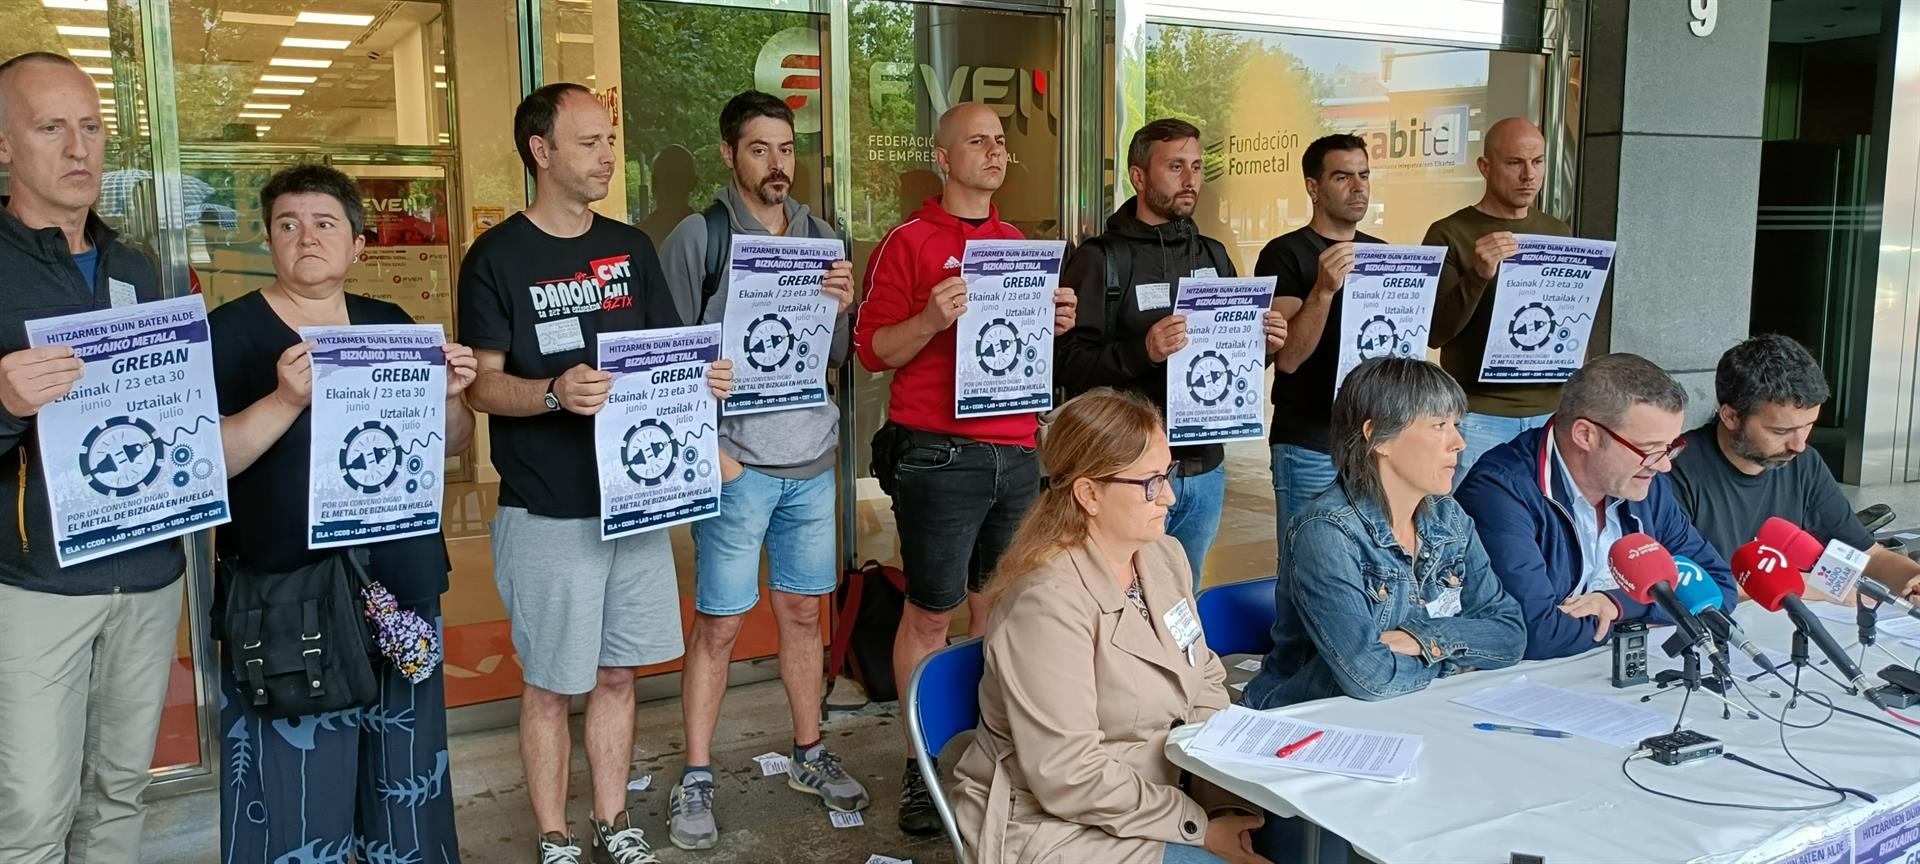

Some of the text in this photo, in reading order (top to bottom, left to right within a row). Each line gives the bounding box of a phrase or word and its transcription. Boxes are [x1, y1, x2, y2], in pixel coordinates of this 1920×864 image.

[1690, 0, 1717, 37] 9
[1229, 130, 1299, 154] Fundación
[869, 150, 937, 163] DE EMPRES
[1228, 152, 1290, 176] Formetal
[741, 246, 838, 257] HITZARMEN DUIN BATEN ALDE
[1564, 246, 1586, 254] BATEN
[755, 259, 823, 269] BIZKAIKO METALA
[598, 261, 631, 281] CNT
[1541, 267, 1592, 279] GREBAN
[1003, 276, 1046, 288] GREBAN
[1383, 278, 1426, 288] GREBAN
[1506, 280, 1537, 288] Ekainak
[1546, 280, 1555, 288] 23
[739, 289, 820, 299] Ekainak 23 eta 30
[968, 292, 1000, 302] Ekainak
[1008, 292, 1017, 300] 23
[1032, 292, 1041, 300] 30
[1352, 291, 1380, 299] Ekainak
[1387, 291, 1396, 299] 23
[1411, 291, 1420, 299] 30
[1542, 294, 1576, 302] Uztailak
[778, 303, 811, 313] Uztailak
[1005, 307, 1036, 317] Uztailak
[1385, 306, 1414, 315] Uztailak
[1214, 311, 1257, 322] GREBAN
[46, 310, 194, 344] HITZARMEN DUIN BATEN ALDE
[1218, 325, 1251, 334] 23 eta 30
[74, 330, 177, 358] BIZKAIKO METALA
[316, 336, 434, 345] HITZARMEN DUIN BATEN ALDE
[609, 337, 712, 353] HITZARMEN DUIN BATEN ALDE
[1215, 340, 1246, 349] Uztailak
[112, 348, 189, 375] GREBAN
[340, 350, 422, 360] BIZKAIKO METALA
[625, 351, 698, 367] BIZKAIKO METALA
[125, 378, 140, 391] 23
[145, 374, 166, 386] eta
[169, 369, 185, 382] 30
[372, 368, 430, 382] GREBAN
[651, 366, 704, 385] GREBAN
[326, 387, 426, 399] Ekainak 23 eta 30
[608, 384, 698, 404] Ekainak 23 eta 30
[80, 397, 112, 415] junio
[126, 389, 202, 413] Uztailak 1
[345, 401, 370, 414] junio
[159, 406, 183, 422] julio
[380, 406, 436, 419] Uztailak 1
[625, 402, 648, 415] junio
[656, 401, 707, 416] Uztailak 1
[402, 420, 420, 432] julio
[676, 414, 694, 425] julio
[67, 491, 169, 522] POR UN CONVENIO DIGNO
[68, 489, 214, 532] EL METAL DE BIZKAIA EN HUELGA
[321, 510, 331, 519] EL
[332, 508, 358, 518] METAL
[359, 507, 368, 516] DE
[369, 504, 398, 515] BIZKAIA
[399, 503, 408, 511] EN
[408, 500, 433, 509] HUELGA
[66, 544, 81, 555] ELA
[86, 538, 107, 550] CCOO
[111, 532, 126, 544] LAB
[132, 528, 146, 538] UGT
[151, 522, 166, 533] ESK
[170, 517, 185, 528] USO
[208, 508, 222, 518] CNT
[1862, 814, 1905, 840] HITZARMEN
[1879, 828, 1919, 856] BIZKAIKO
[1826, 840, 1844, 858] ALDE
